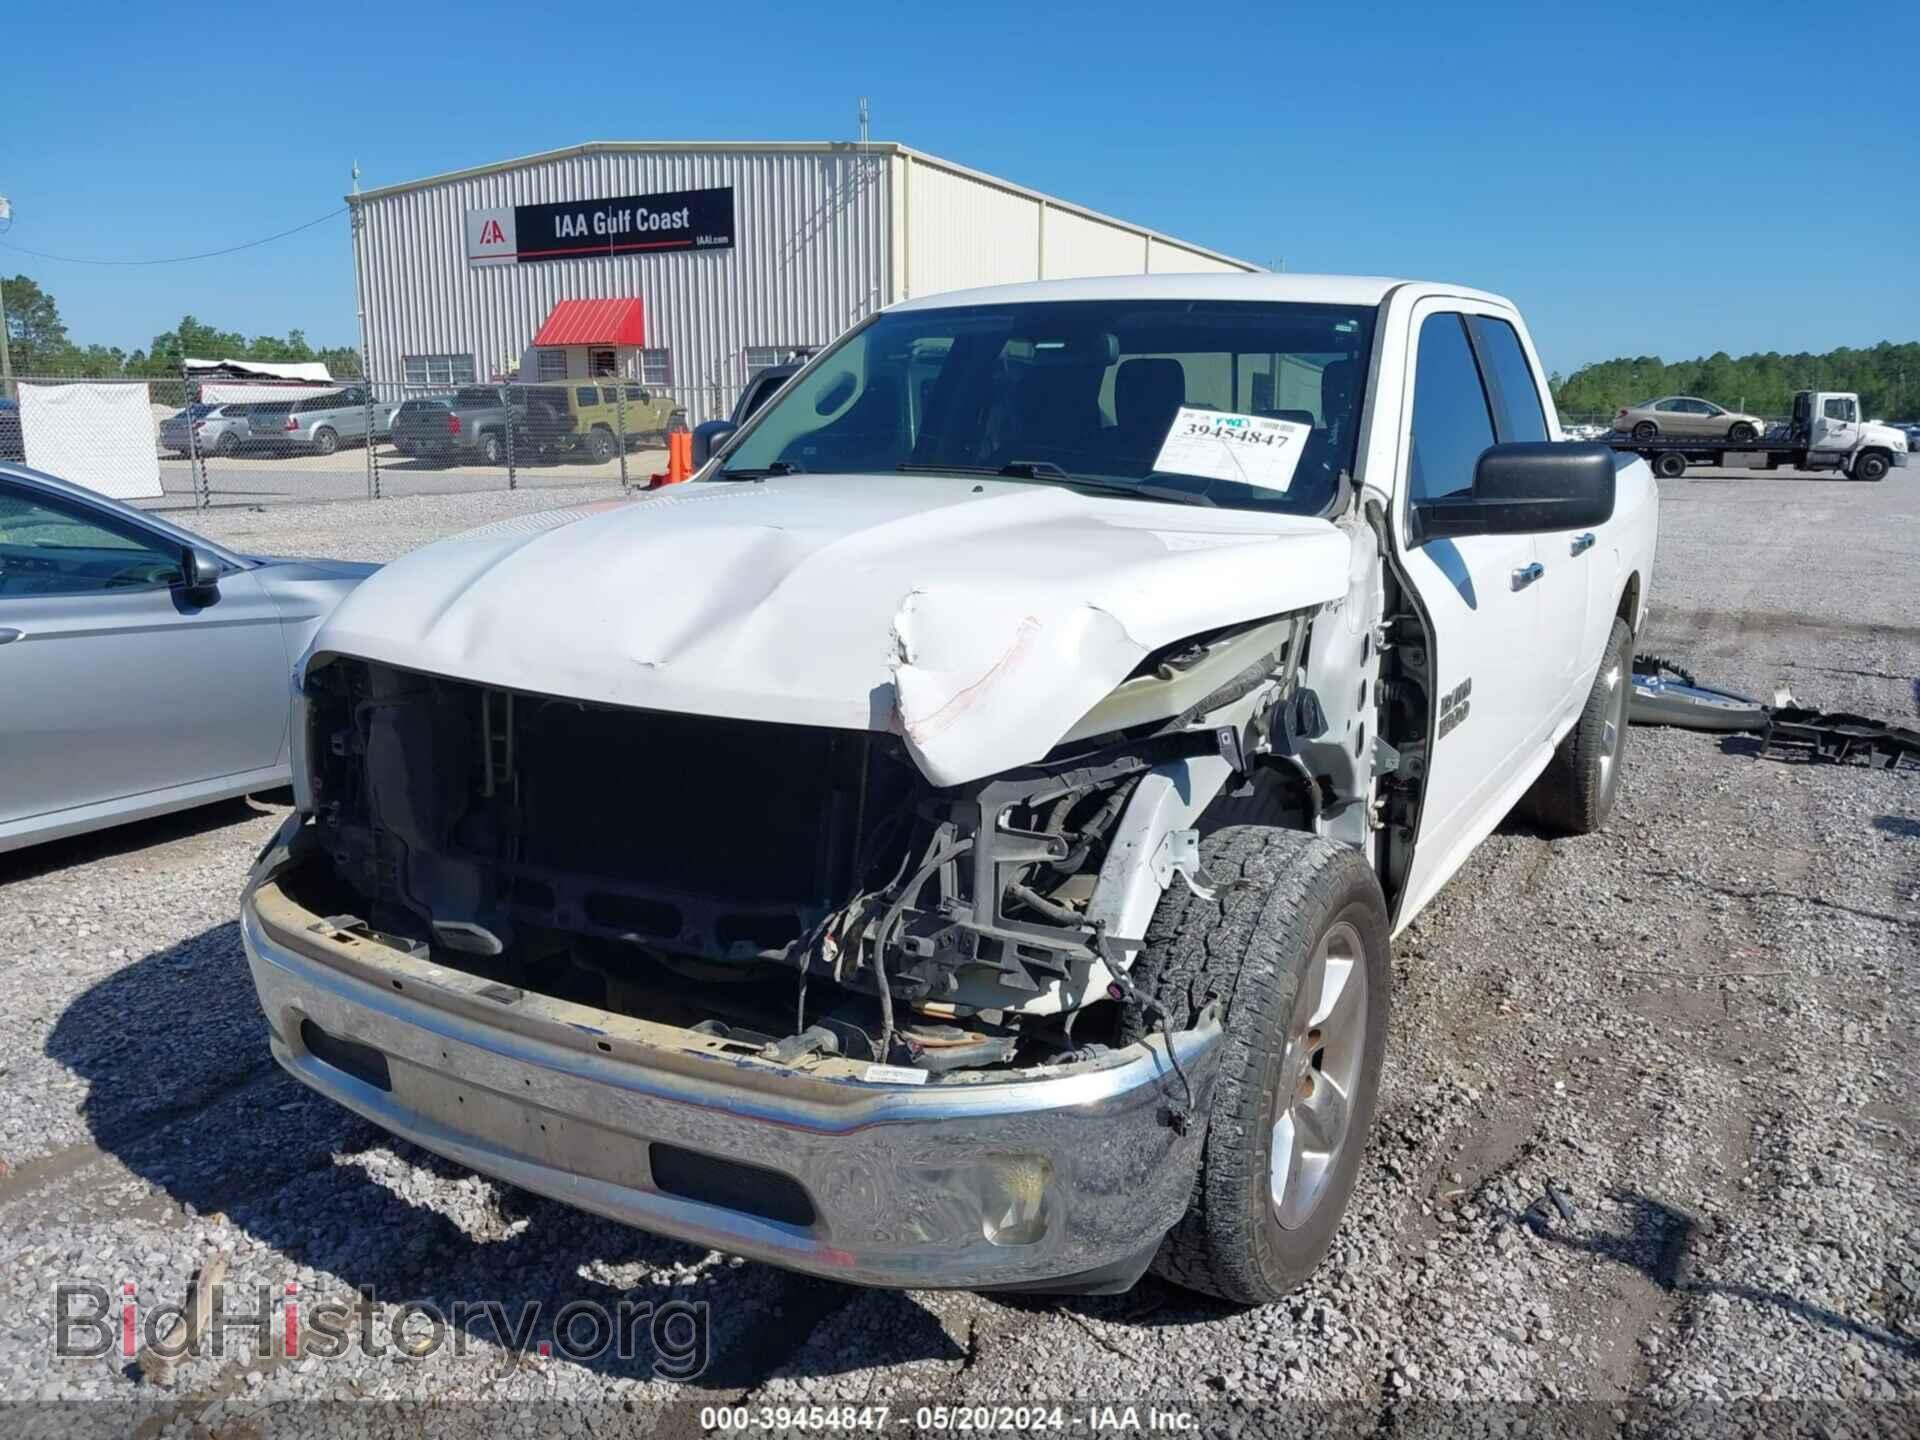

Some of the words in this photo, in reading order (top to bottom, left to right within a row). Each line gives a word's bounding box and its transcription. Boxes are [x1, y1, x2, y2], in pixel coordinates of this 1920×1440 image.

[555, 213, 588, 238] IAA
[593, 208, 631, 235] Gulf
[636, 207, 690, 231] Coast
[1183, 423, 1289, 448] 39454847
